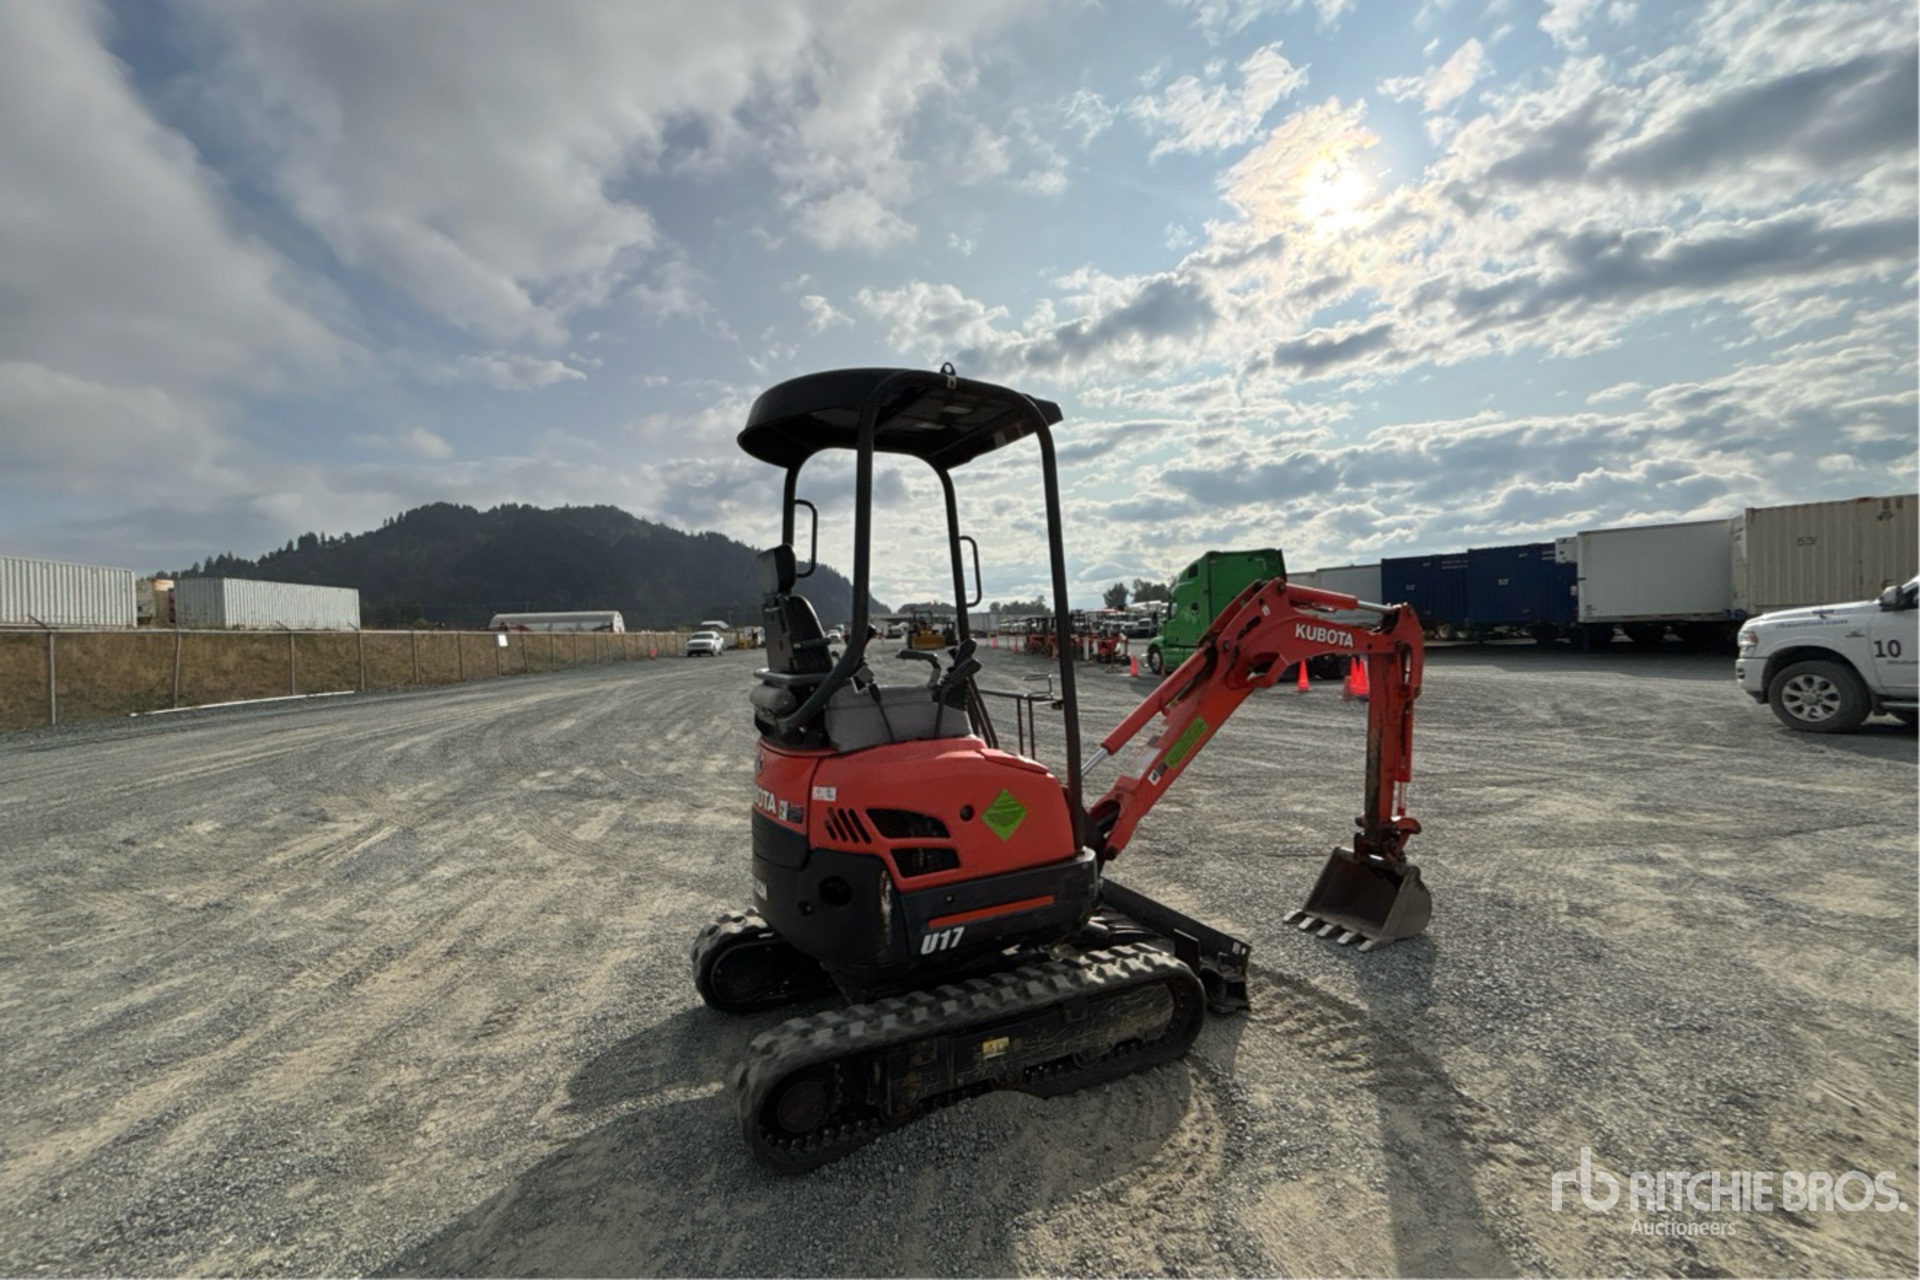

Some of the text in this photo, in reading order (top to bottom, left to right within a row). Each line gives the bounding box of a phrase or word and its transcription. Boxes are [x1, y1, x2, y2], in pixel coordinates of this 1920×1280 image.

[1295, 623, 1354, 648] KUBOTA
[1873, 639, 1902, 658] 10
[920, 926, 965, 955] U17
